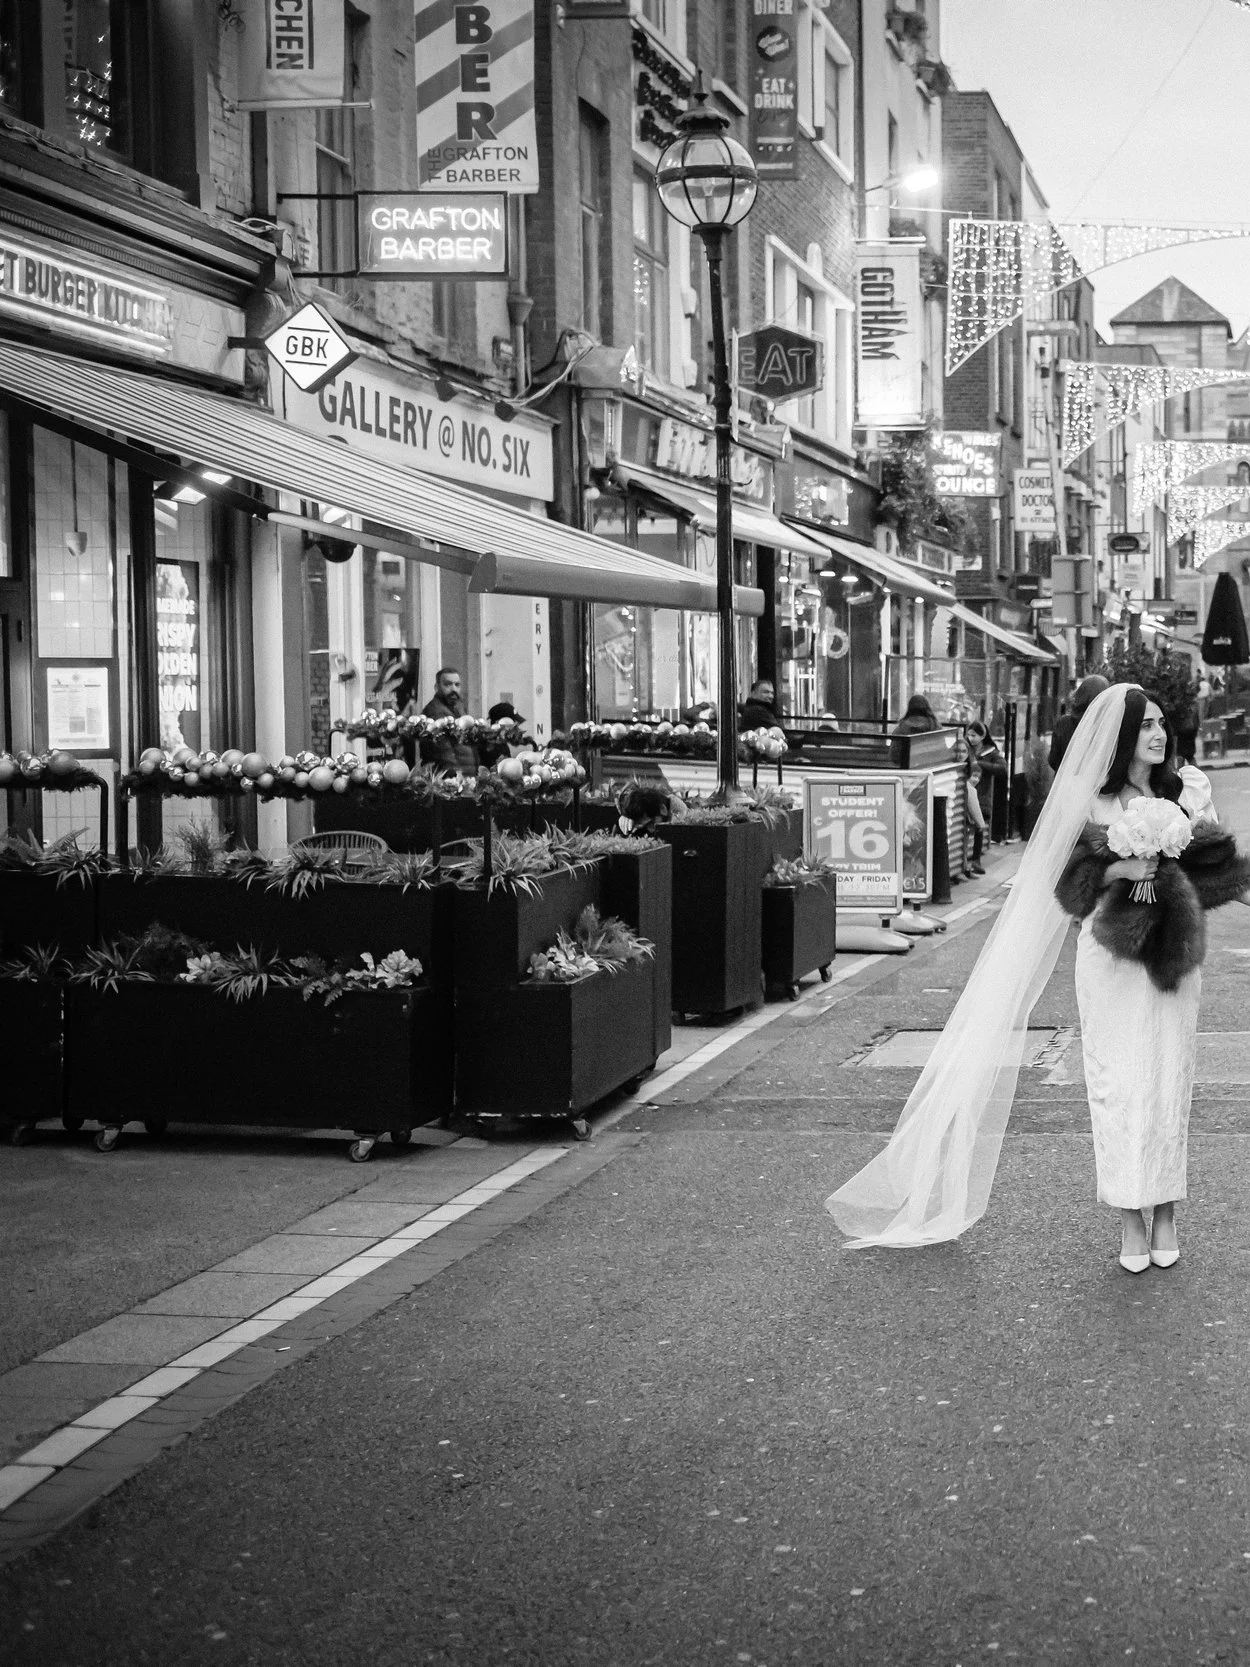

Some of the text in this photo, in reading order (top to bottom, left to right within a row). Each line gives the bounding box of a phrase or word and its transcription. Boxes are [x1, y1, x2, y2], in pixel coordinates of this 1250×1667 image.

[455, 5, 498, 141] BER
[762, 78, 786, 93] EAT
[754, 94, 795, 109] DRINK
[427, 148, 442, 183] THE
[443, 146, 529, 162] GRAFTON
[446, 168, 521, 183] BARBER
[371, 207, 502, 232] GRAFTON
[380, 237, 492, 261] BARBER
[19, 255, 98, 317] BURGER
[860, 266, 912, 361] GOTHAM
[285, 334, 329, 360] GBK
[740, 343, 814, 386] EAT
[318, 375, 532, 479] GALLERY @ NO. SIX
[930, 434, 995, 476] KEHOES
[934, 476, 996, 495] OUNGE
[1018, 476, 1052, 489] COSMET
[159, 684, 198, 712] NION
[821, 796, 885, 807] STUDENT
[827, 808, 878, 819] OFFER!
[851, 862, 882, 872] TRIM
[836, 875, 893, 884] DAY FRIDAY
